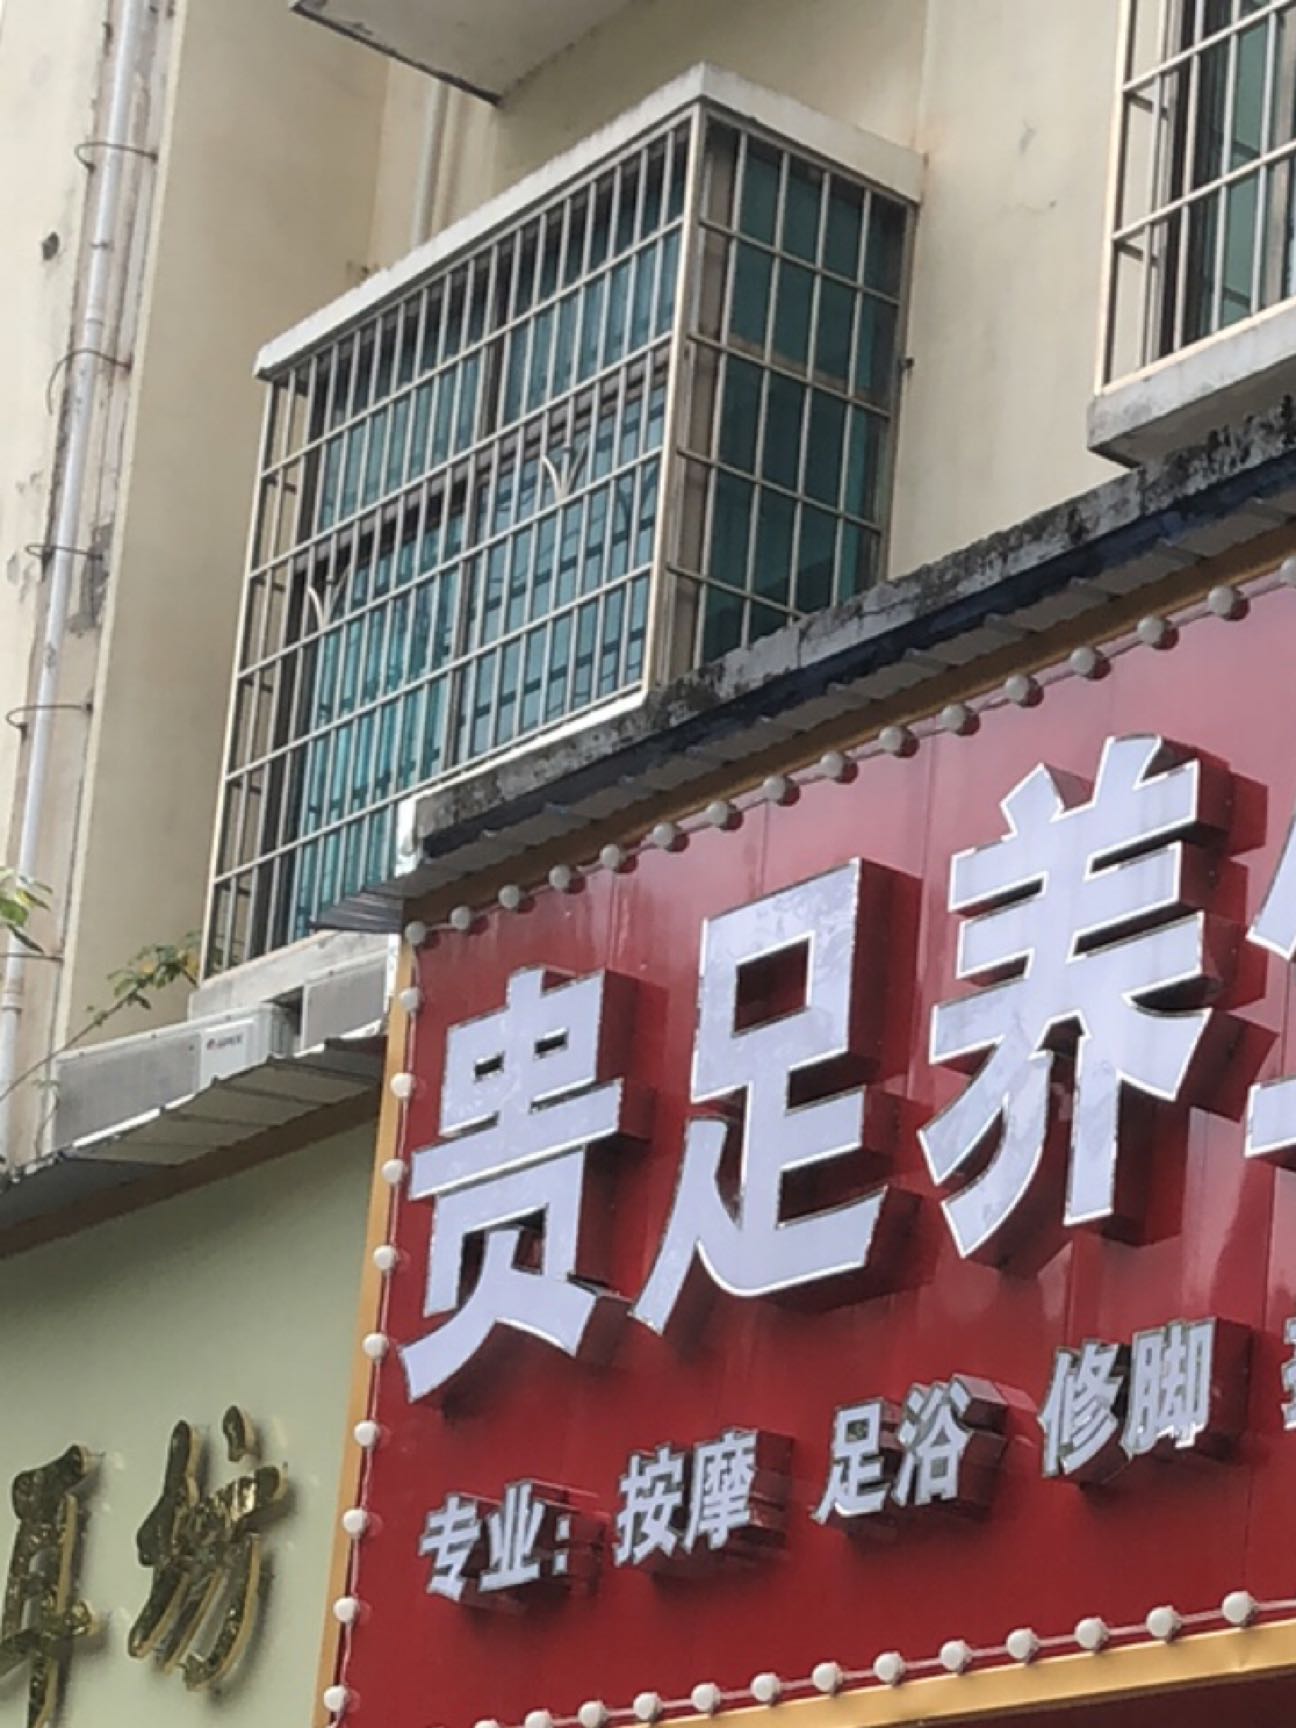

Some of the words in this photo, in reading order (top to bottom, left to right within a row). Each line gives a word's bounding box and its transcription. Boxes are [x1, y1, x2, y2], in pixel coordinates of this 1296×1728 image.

[613, 1427, 757, 1567] 按摩
[811, 1379, 972, 1524] 足浴
[1036, 1319, 1216, 1478] 修脚
